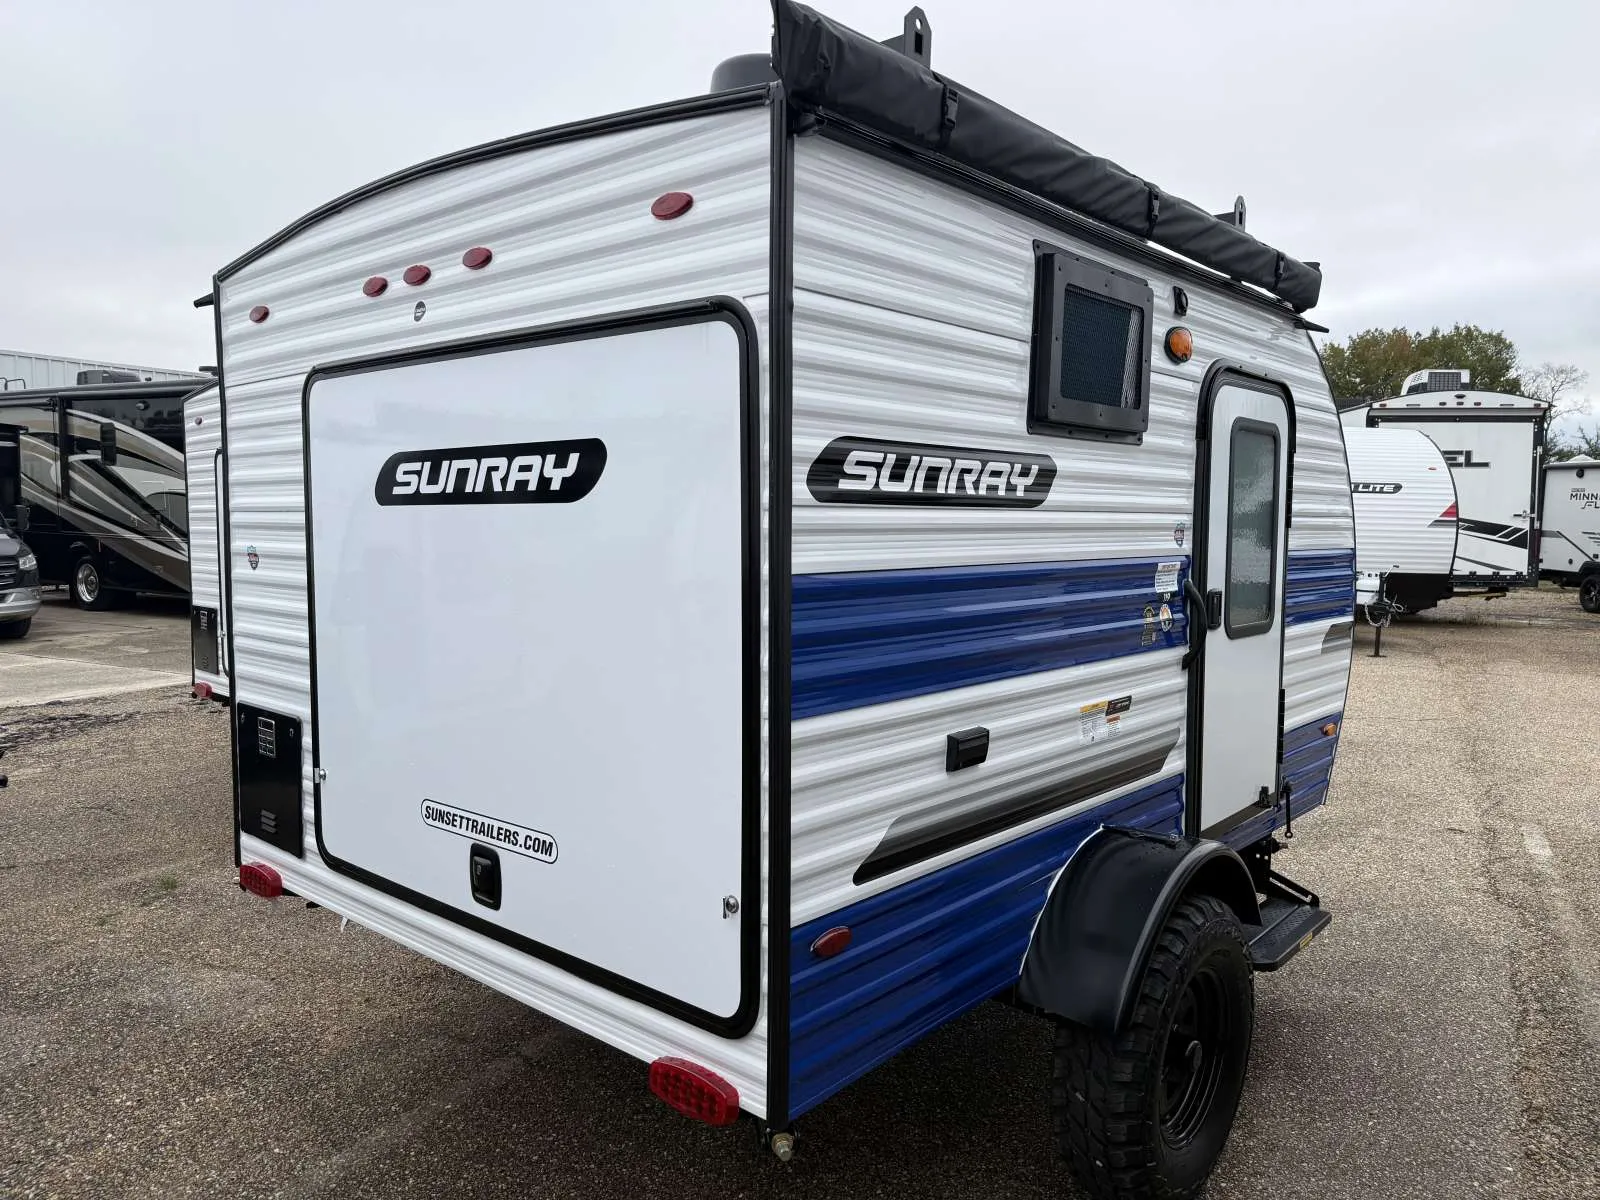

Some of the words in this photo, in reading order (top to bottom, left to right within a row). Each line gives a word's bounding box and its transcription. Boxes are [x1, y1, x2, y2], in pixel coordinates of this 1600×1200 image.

[392, 452, 580, 495] SUNRAY
[838, 450, 1039, 496] SUNRAY
[1358, 484, 1395, 493] LITE
[424, 805, 554, 857] SUNSETTRAILERS.COM
